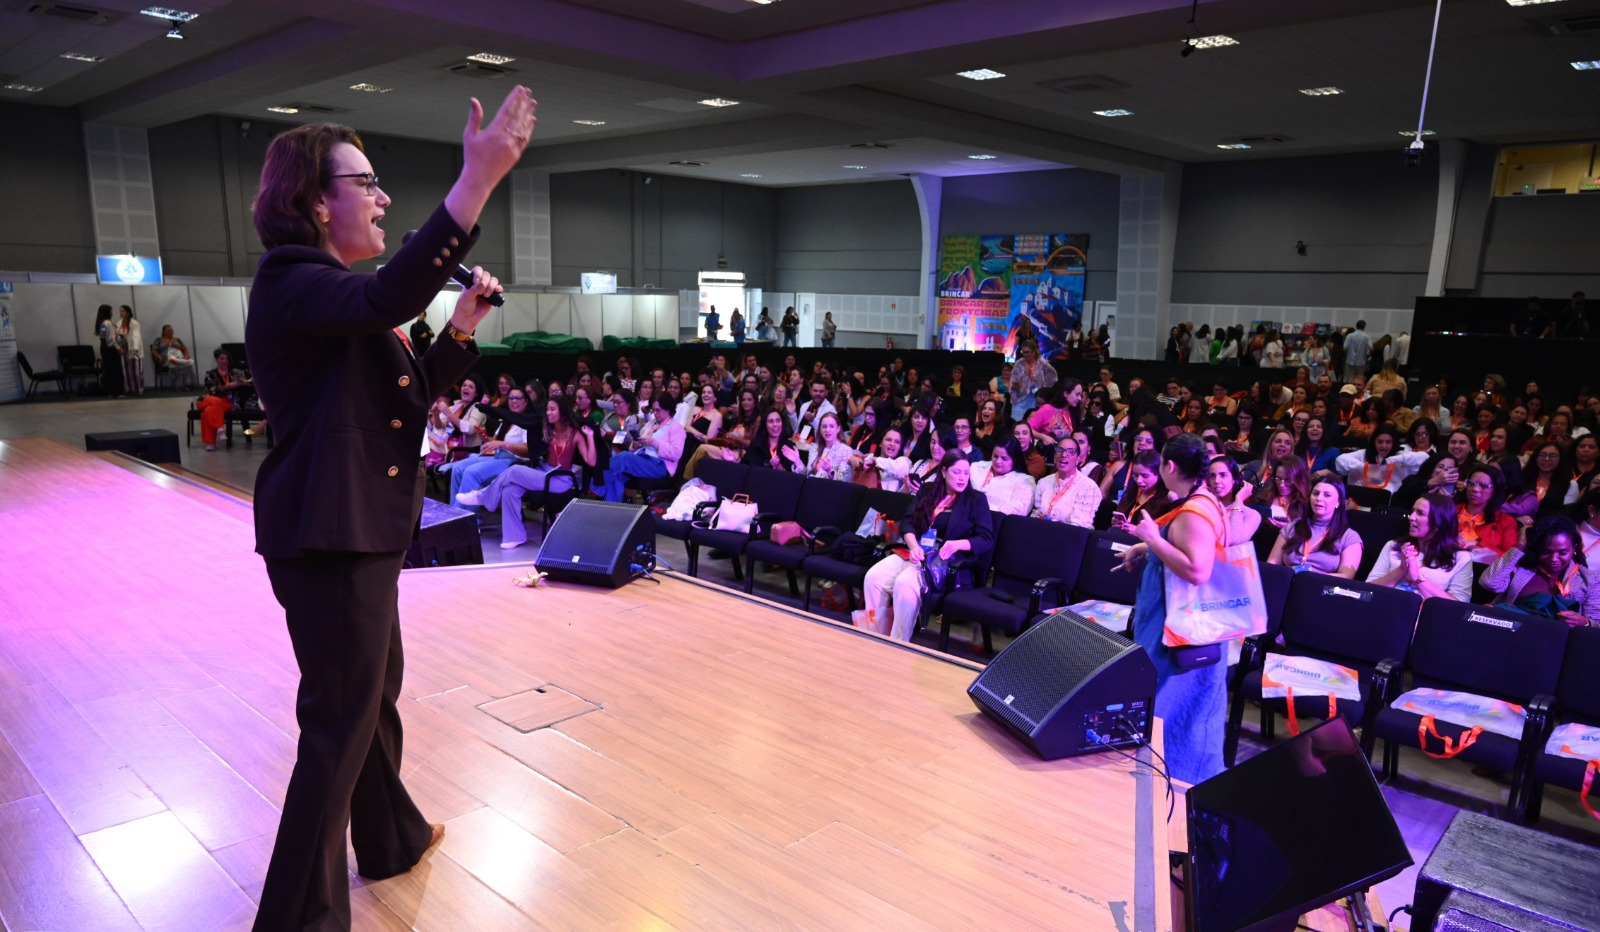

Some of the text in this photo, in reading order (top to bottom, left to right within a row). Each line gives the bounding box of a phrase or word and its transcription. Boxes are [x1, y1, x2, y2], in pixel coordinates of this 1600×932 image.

[940, 290, 970, 298] BRINCAR
[940, 300, 984, 308] BRINCAR
[940, 308, 1007, 317] FRONTEIRAS
[1201, 597, 1251, 612] BRINCAR
[1474, 616, 1511, 628] RESERVADO
[1275, 663, 1321, 679] BRINCAR
